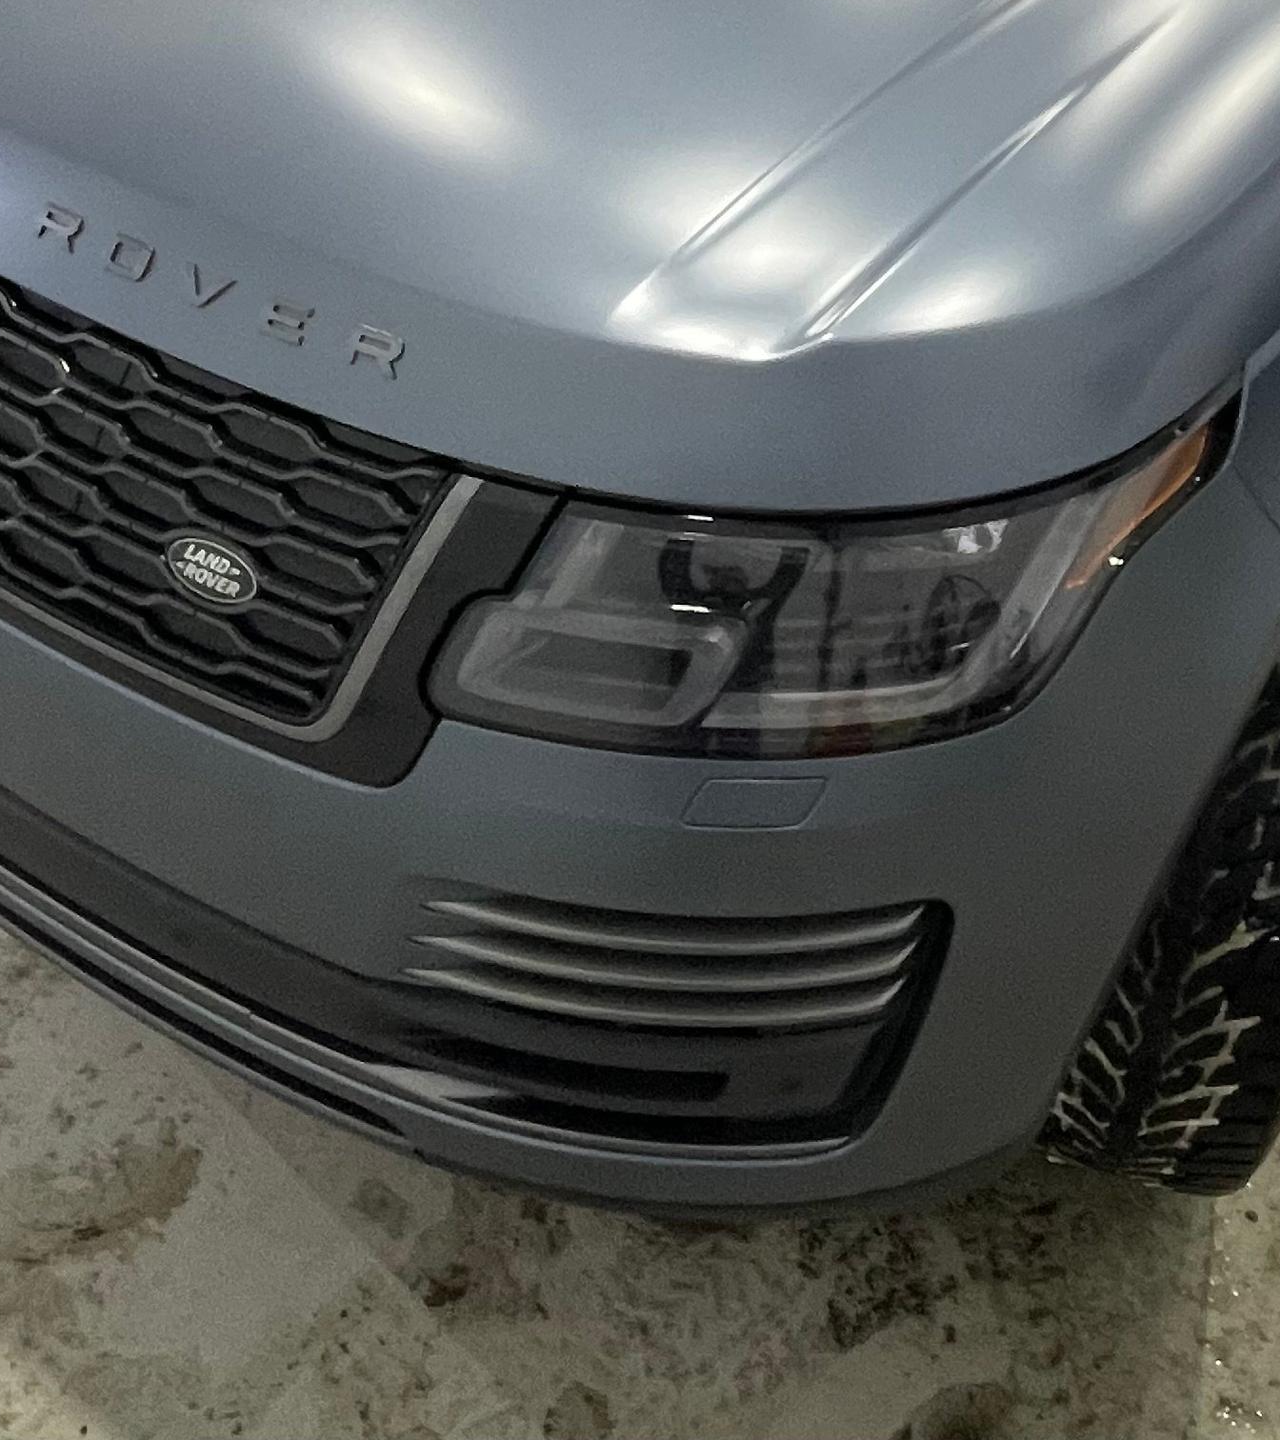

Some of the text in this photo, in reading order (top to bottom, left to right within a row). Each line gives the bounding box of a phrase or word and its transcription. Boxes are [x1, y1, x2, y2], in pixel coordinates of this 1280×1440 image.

[37, 201, 407, 380] ROVER
[183, 543, 231, 574] LAND
[183, 562, 241, 598] ROVER
